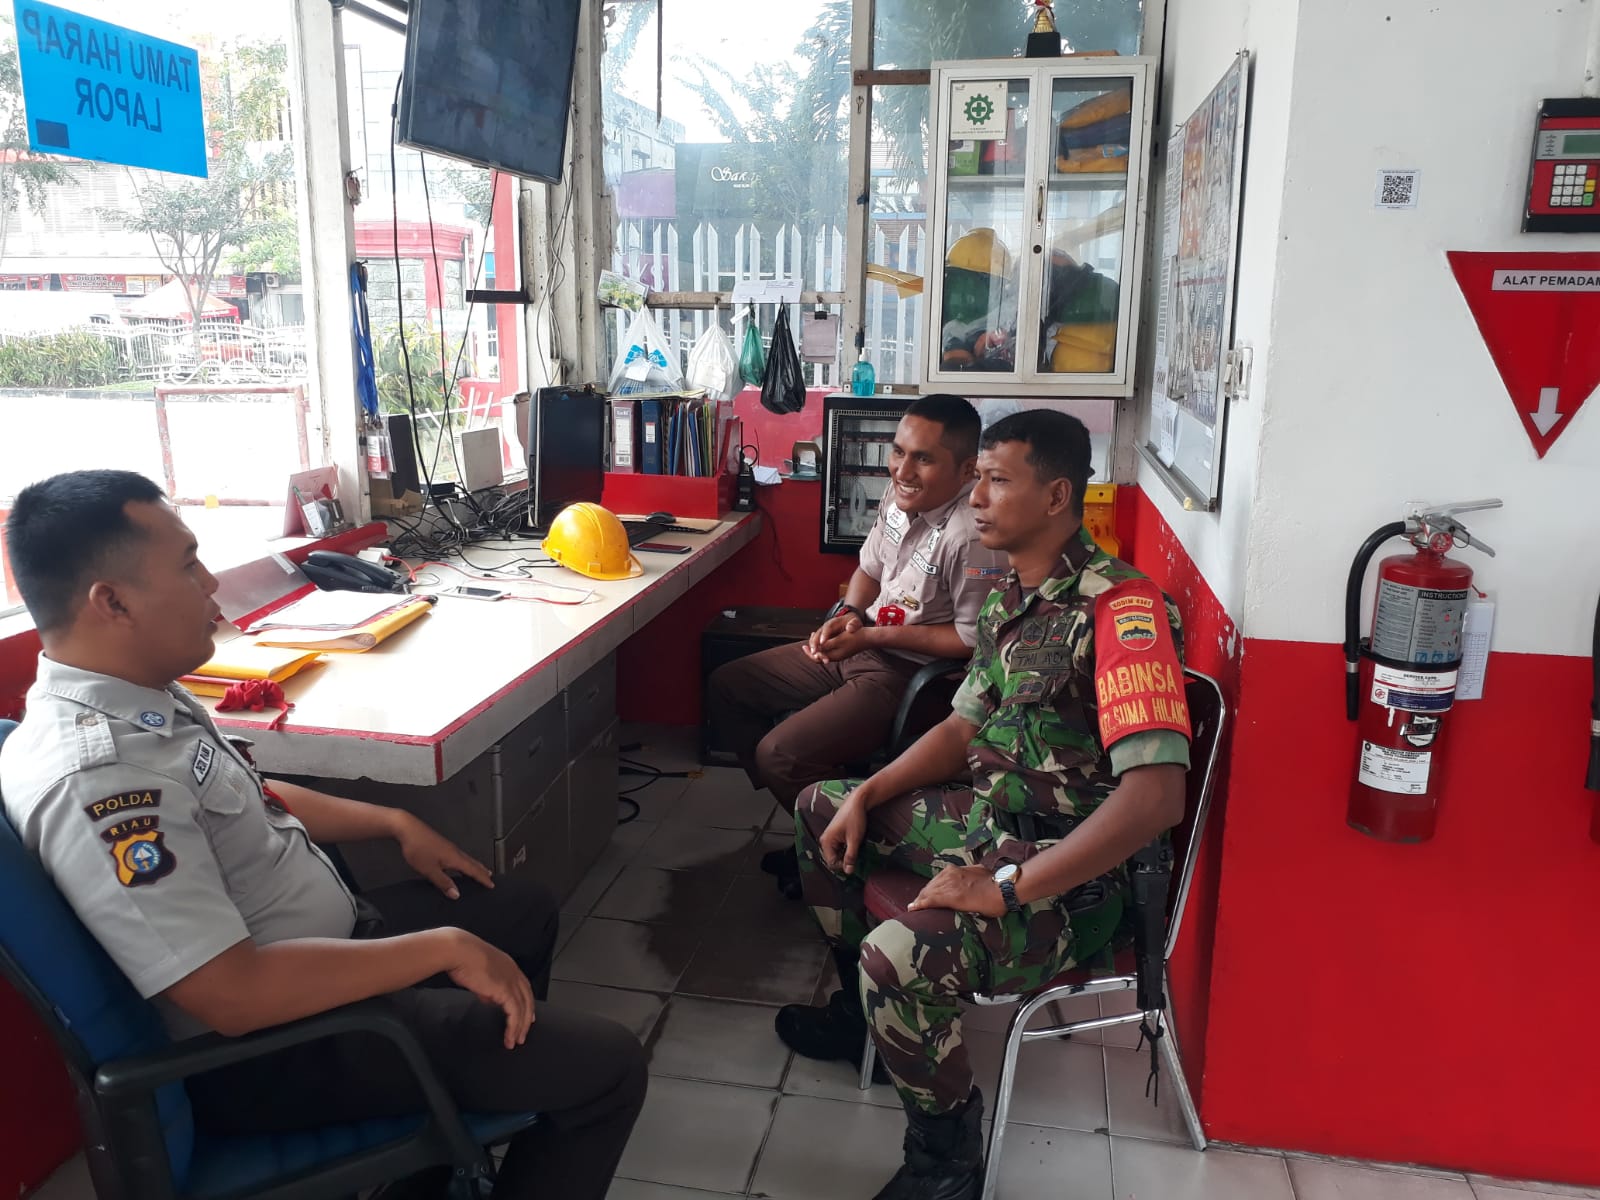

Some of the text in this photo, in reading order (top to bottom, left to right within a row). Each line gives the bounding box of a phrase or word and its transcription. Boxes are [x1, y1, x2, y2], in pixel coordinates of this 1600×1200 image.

[1503, 275, 1536, 286] ALAT
[1098, 660, 1178, 708] BABINSA
[1151, 697, 1188, 729] HILANG
[92, 791, 154, 817] POLDA
[110, 817, 151, 836] RIAU
